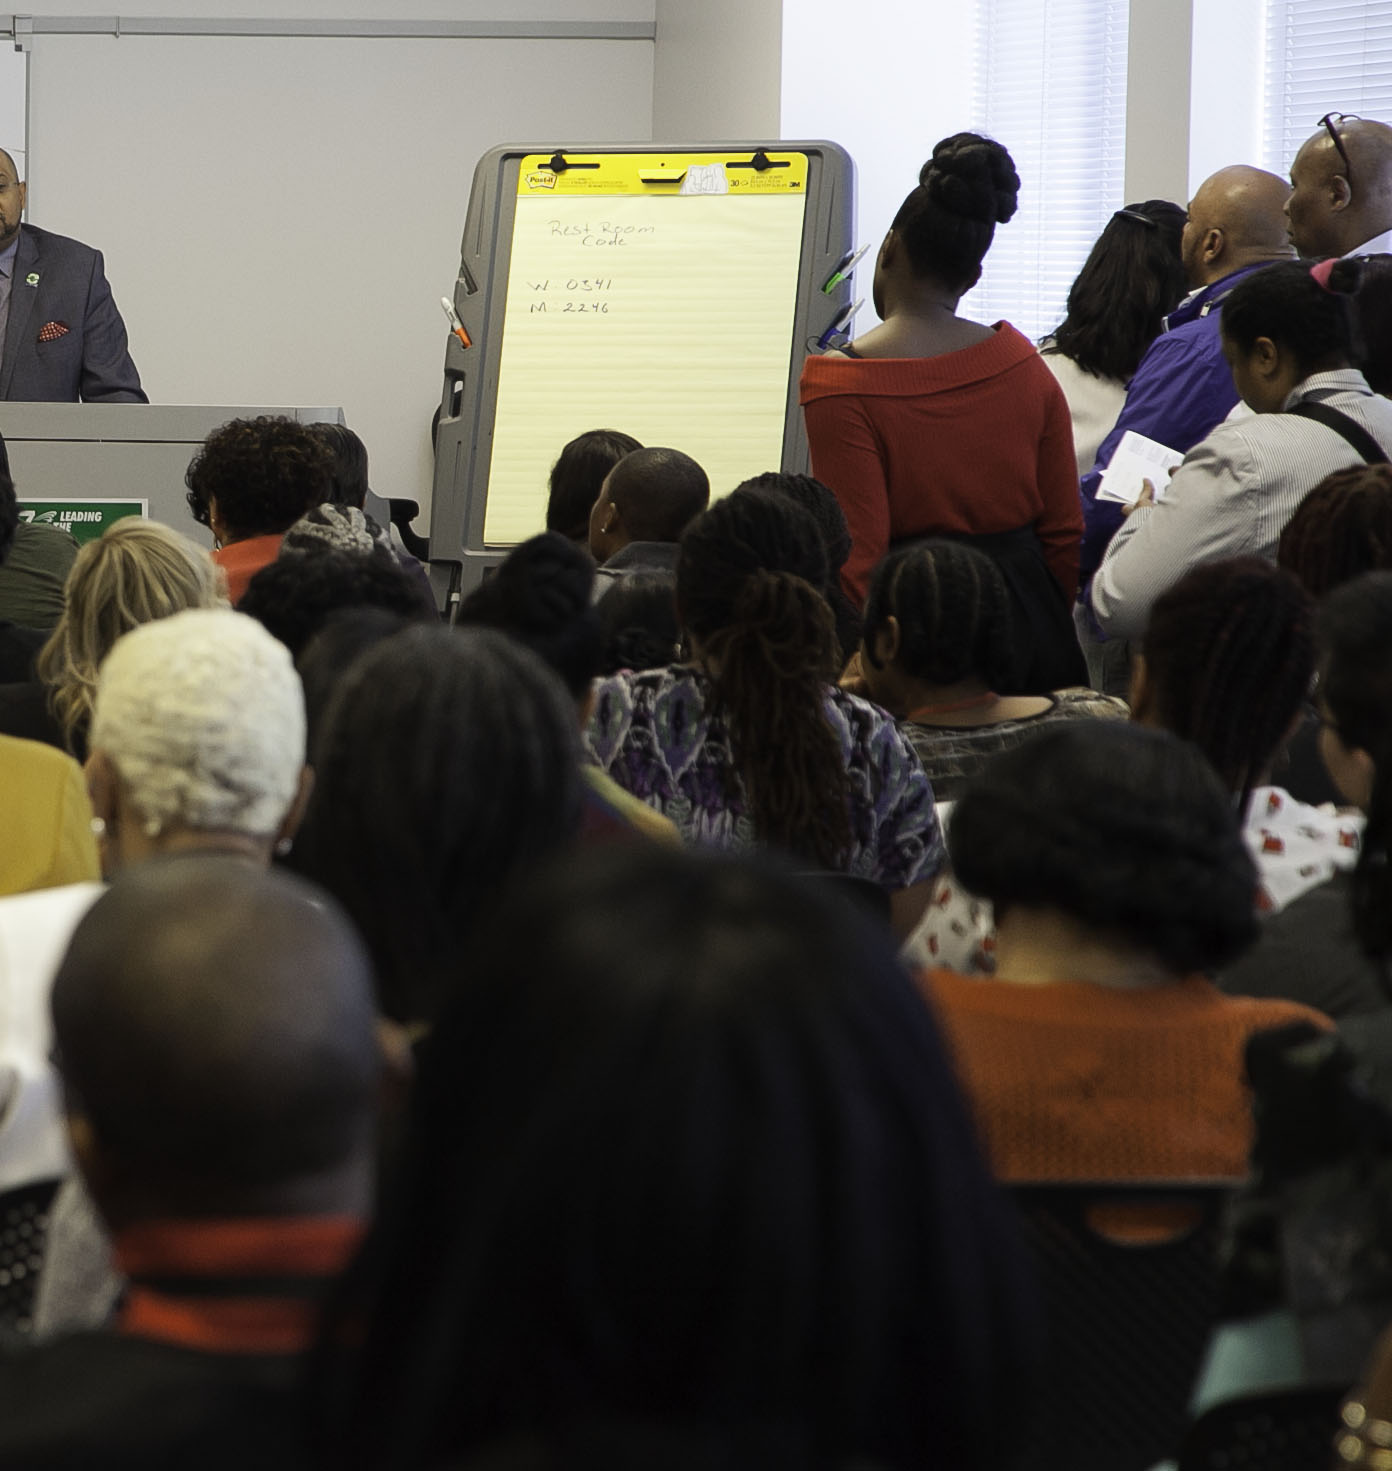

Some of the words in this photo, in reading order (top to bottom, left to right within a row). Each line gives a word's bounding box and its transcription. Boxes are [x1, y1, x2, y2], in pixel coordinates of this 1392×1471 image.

[529, 176, 554, 184] Post-it
[548, 219, 590, 236] Rest
[582, 232, 628, 246] Code
[566, 279, 612, 291] 0341
[563, 302, 609, 313] 2246
[60, 511, 102, 522] LEADING
